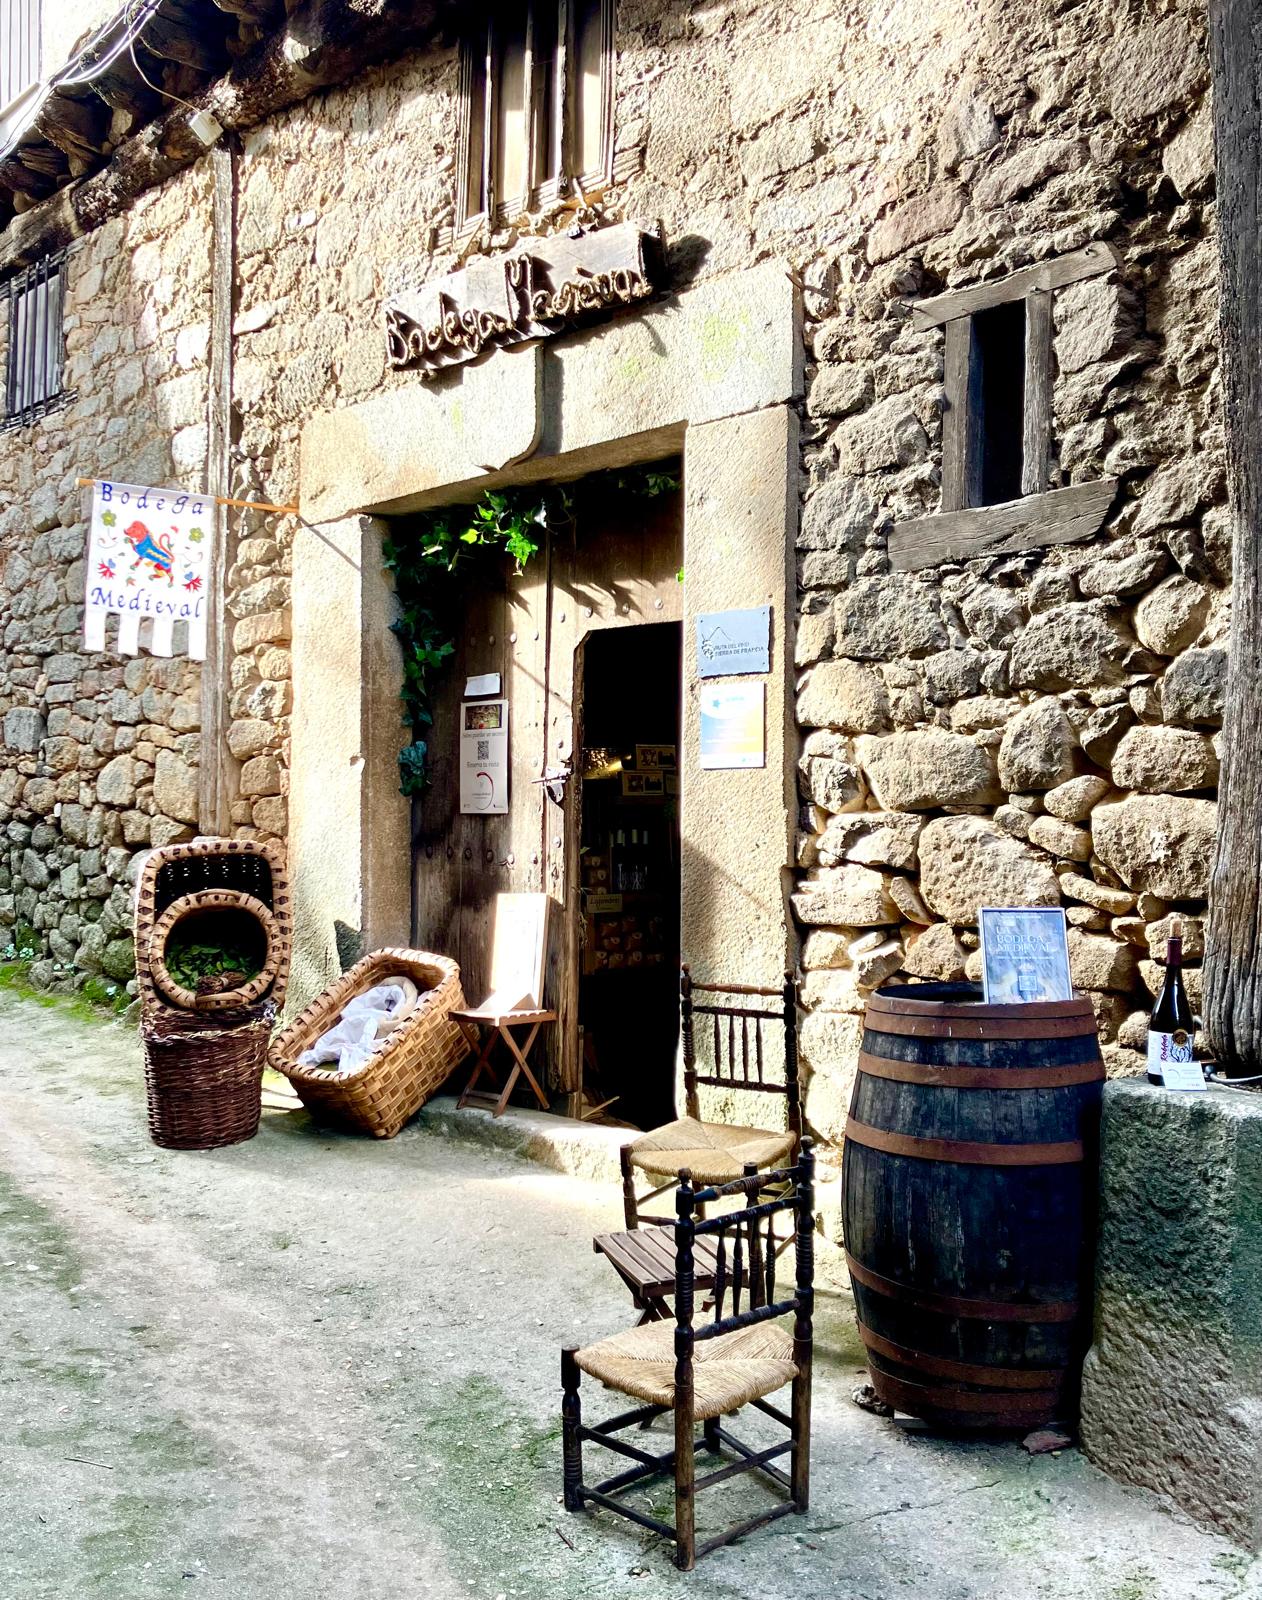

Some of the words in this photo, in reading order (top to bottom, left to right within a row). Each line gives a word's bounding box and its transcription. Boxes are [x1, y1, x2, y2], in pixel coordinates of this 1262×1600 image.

[385, 292, 510, 366] Bodega
[101, 482, 204, 515] Bodega
[91, 586, 205, 618] Medieval
[996, 934, 1045, 943] BODEGA
[996, 943, 1051, 952] MEDIEVAL
